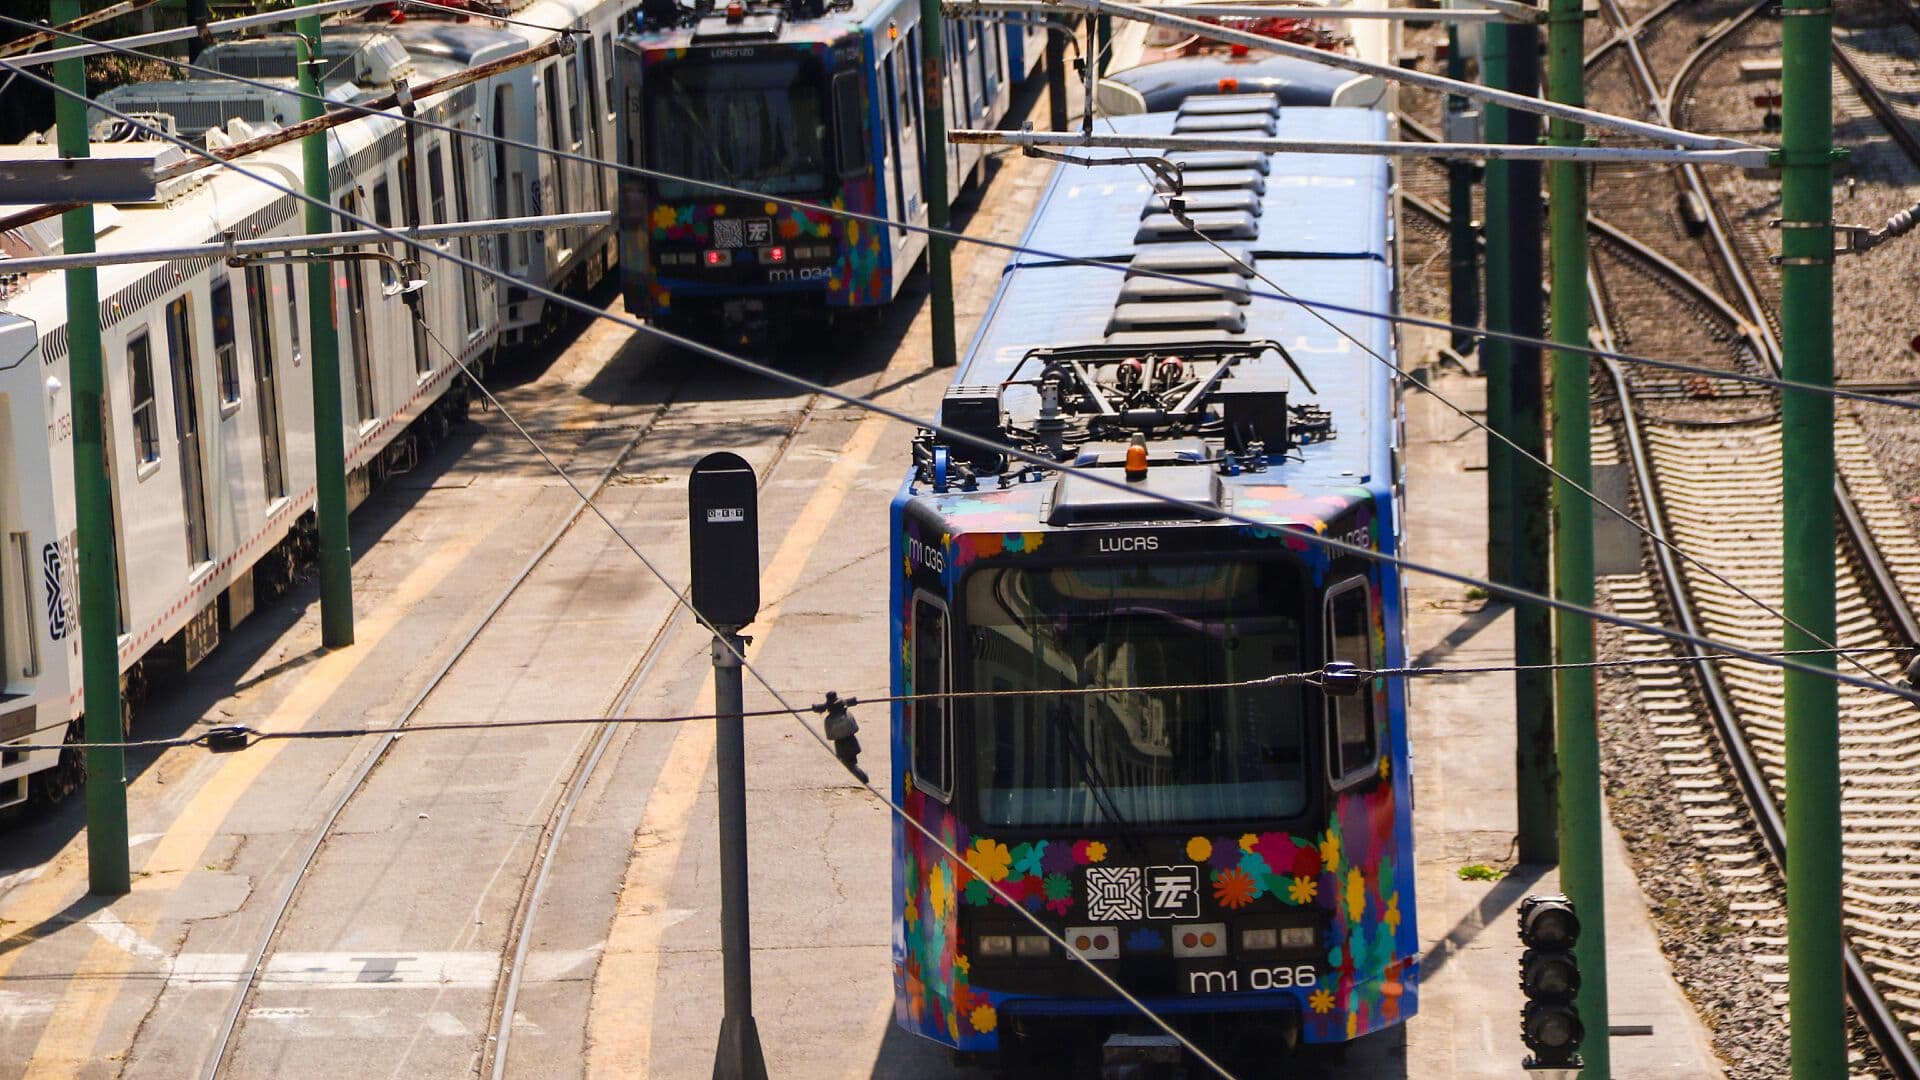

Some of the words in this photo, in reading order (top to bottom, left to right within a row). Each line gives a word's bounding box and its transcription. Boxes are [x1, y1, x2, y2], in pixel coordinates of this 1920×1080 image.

[711, 48, 754, 58] LORENZO
[801, 267, 832, 280] 034
[1099, 536, 1159, 552] LUCAS
[925, 545, 943, 574] 036
[1251, 966, 1316, 990] 036
